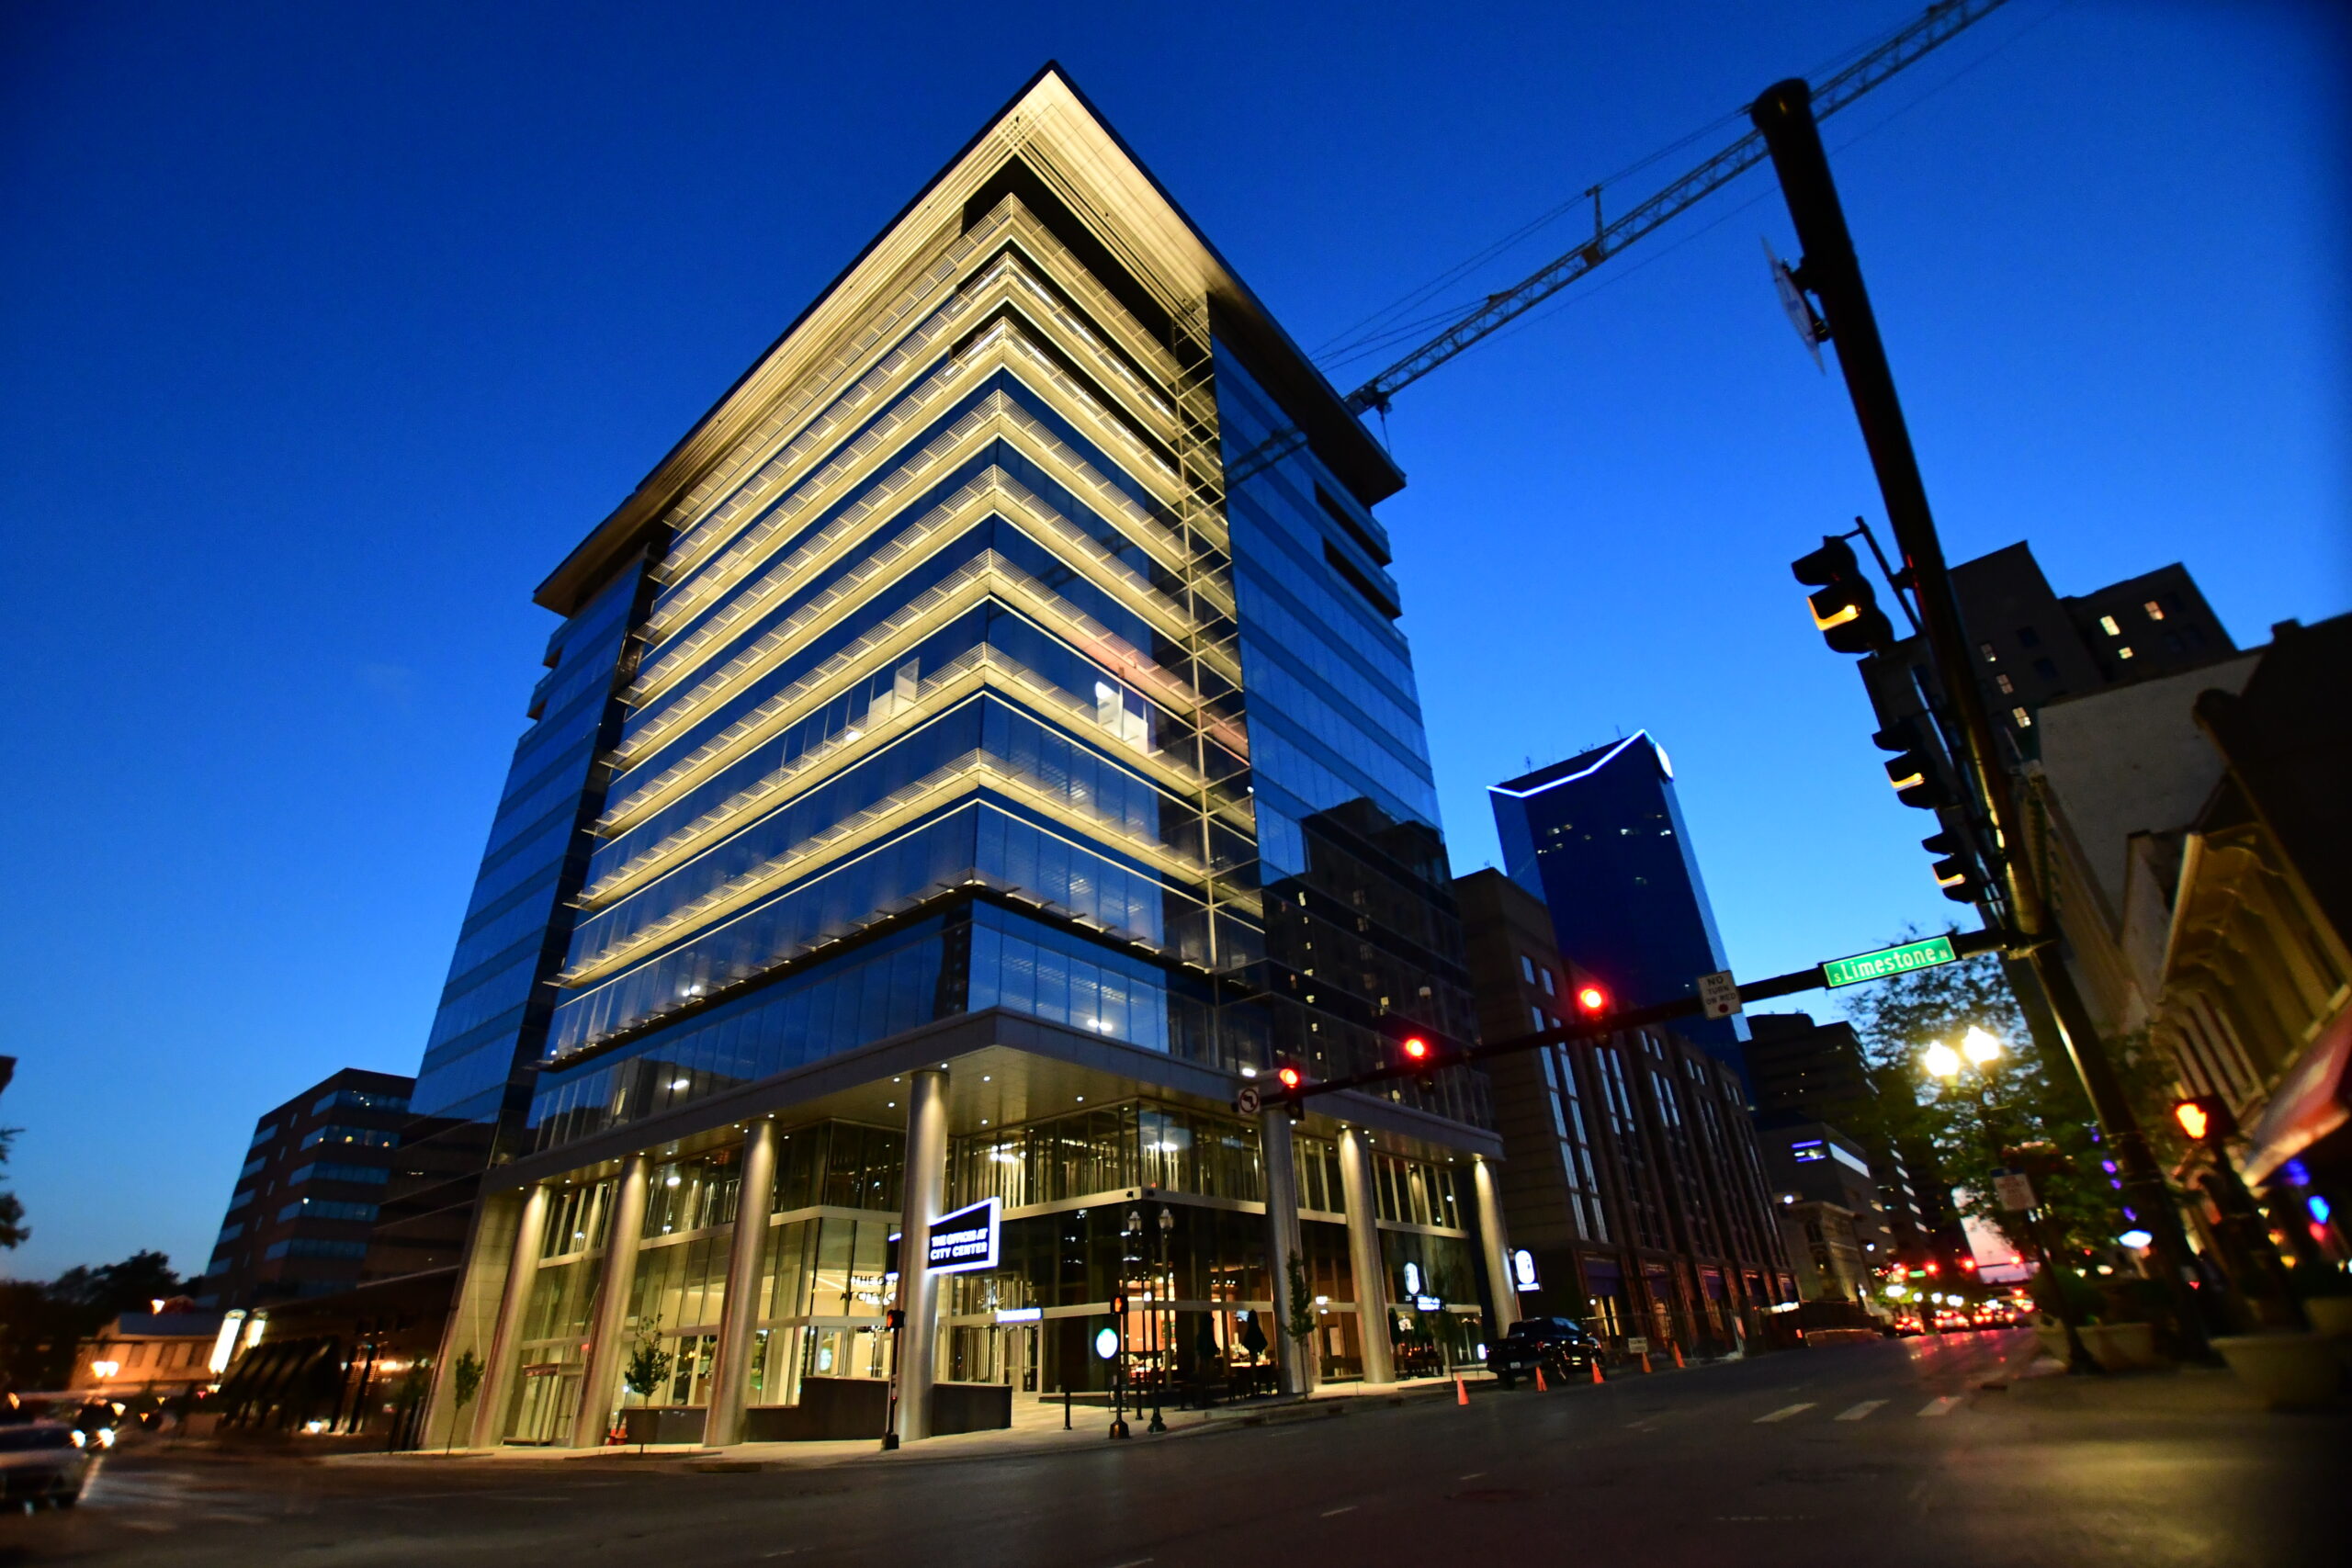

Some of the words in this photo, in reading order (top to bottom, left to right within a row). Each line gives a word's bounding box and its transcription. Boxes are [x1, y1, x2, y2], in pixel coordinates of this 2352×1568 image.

[1834, 973, 1842, 983] S
[1840, 947, 1937, 981] Limestone
[1939, 949, 1949, 959] N
[1707, 976, 1724, 986] NO
[1708, 986, 1729, 995] TURN
[932, 1235, 947, 1247] THE
[977, 1227, 989, 1240] AT
[930, 1247, 952, 1260] CITY
[952, 1241, 988, 1258] CENTER
